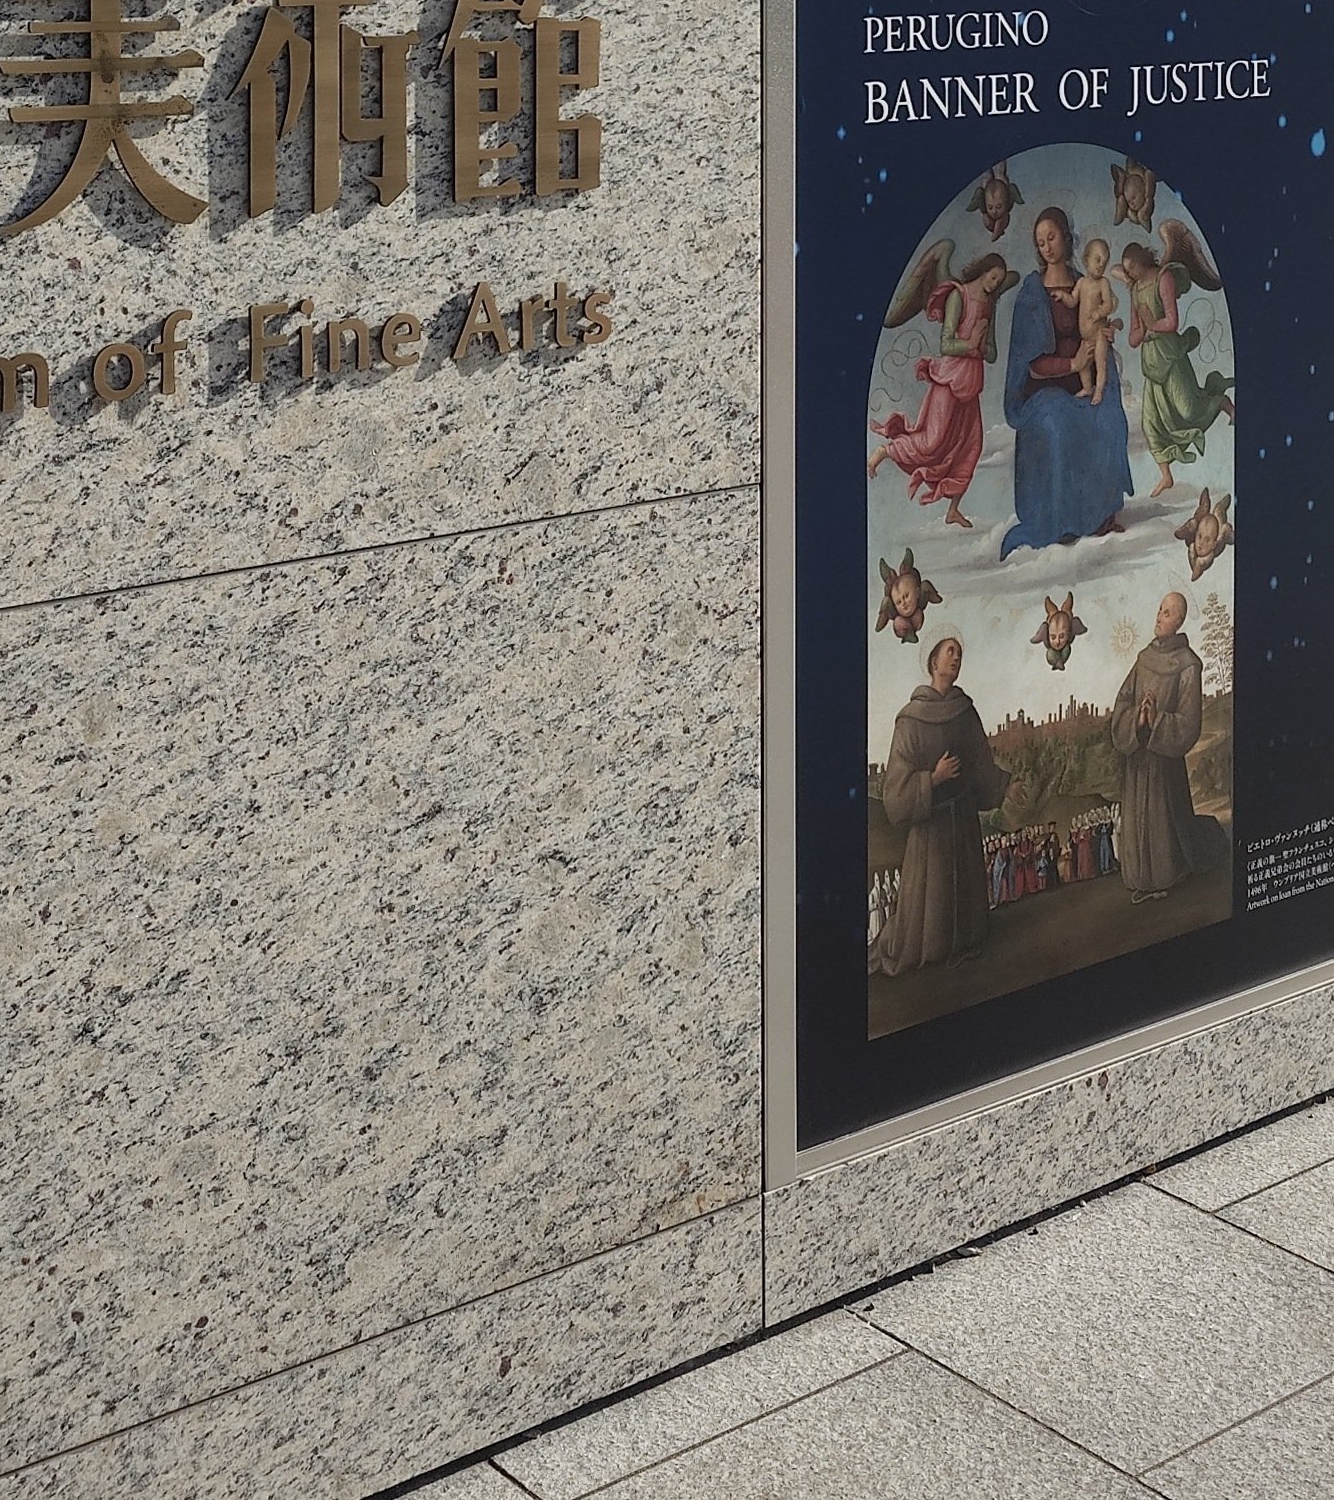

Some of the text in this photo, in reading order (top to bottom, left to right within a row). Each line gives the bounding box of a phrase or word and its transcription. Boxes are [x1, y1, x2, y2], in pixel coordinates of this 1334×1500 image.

[863, 10, 1049, 54] PERUGINO
[864, 59, 1272, 124] BANNER OF JUSTICE
[93, 308, 193, 402] of
[249, 299, 422, 383] Fine
[452, 281, 615, 360] Arts
[1247, 895, 1270, 912] Artwork
[1271, 894, 1279, 903] on
[1279, 889, 1291, 900] loan
[1291, 885, 1305, 896] from
[1305, 880, 1315, 891] the
